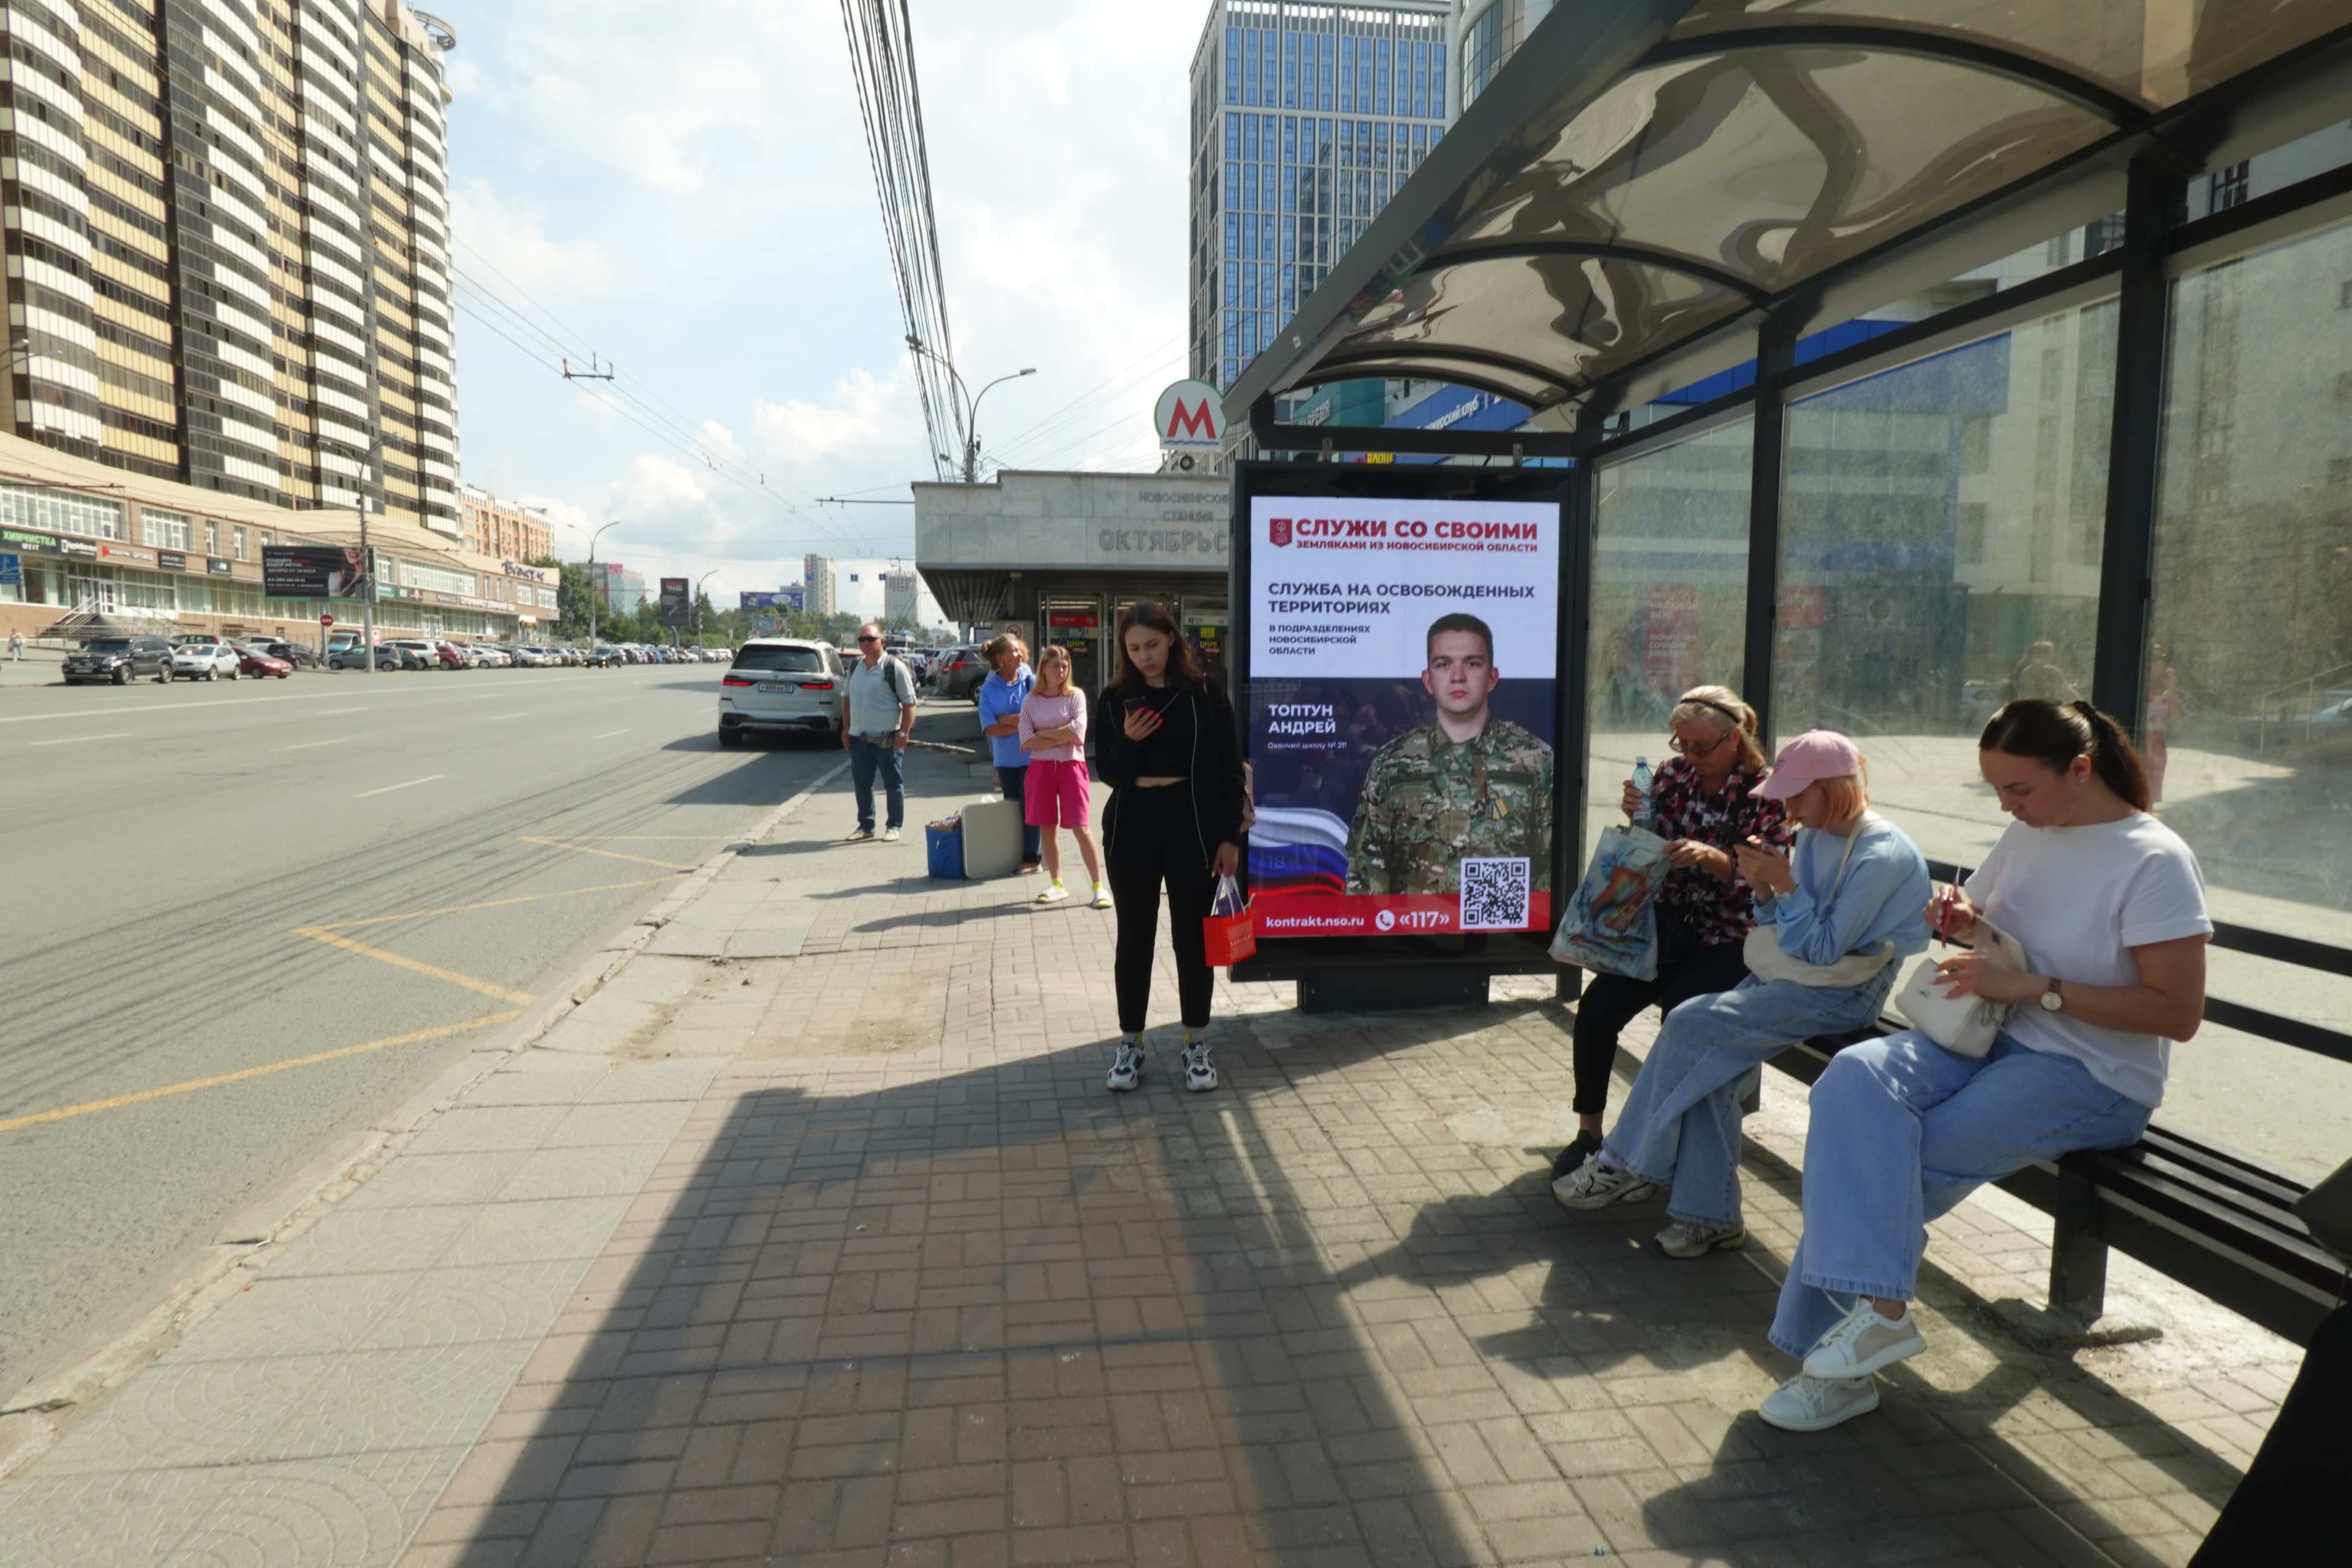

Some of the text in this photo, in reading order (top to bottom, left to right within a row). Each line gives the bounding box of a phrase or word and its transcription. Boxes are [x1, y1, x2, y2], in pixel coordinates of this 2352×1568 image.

[1167, 397, 1216, 439] М
[1139, 491, 1230, 503] НОВОСИБИРСКИ
[1163, 511, 1213, 521] СТАНЦИЯ
[1296, 519, 1537, 540] СЛУЖИ СО СВОИМИ
[3, 530, 57, 546] ХИМЧИСТКА
[1296, 540, 1366, 550] ЗЕМЛЯКАМИ
[1370, 541, 1383, 550] ИЗ
[1387, 541, 1484, 552] НОВОСИБИРСКОЙ
[1487, 543, 1538, 552] ОБЛАСТИ
[1268, 583, 1534, 599] СЛУЖБА НА ОСВОБОЖДЕННЫХ
[1268, 601, 1390, 614] ТЕРРИТОРИЯХ
[1278, 625, 1370, 633] ПОДРАЗДЕЛЕНИЯХ
[1269, 635, 1357, 644] НОВОСИБИРСКОЙ
[1268, 704, 1333, 717] ТОПТУН
[1268, 719, 1336, 735] АНДРЕЙ
[1266, 916, 1365, 927] kontrakt.nso.ru
[1400, 911, 1450, 928] «117»
